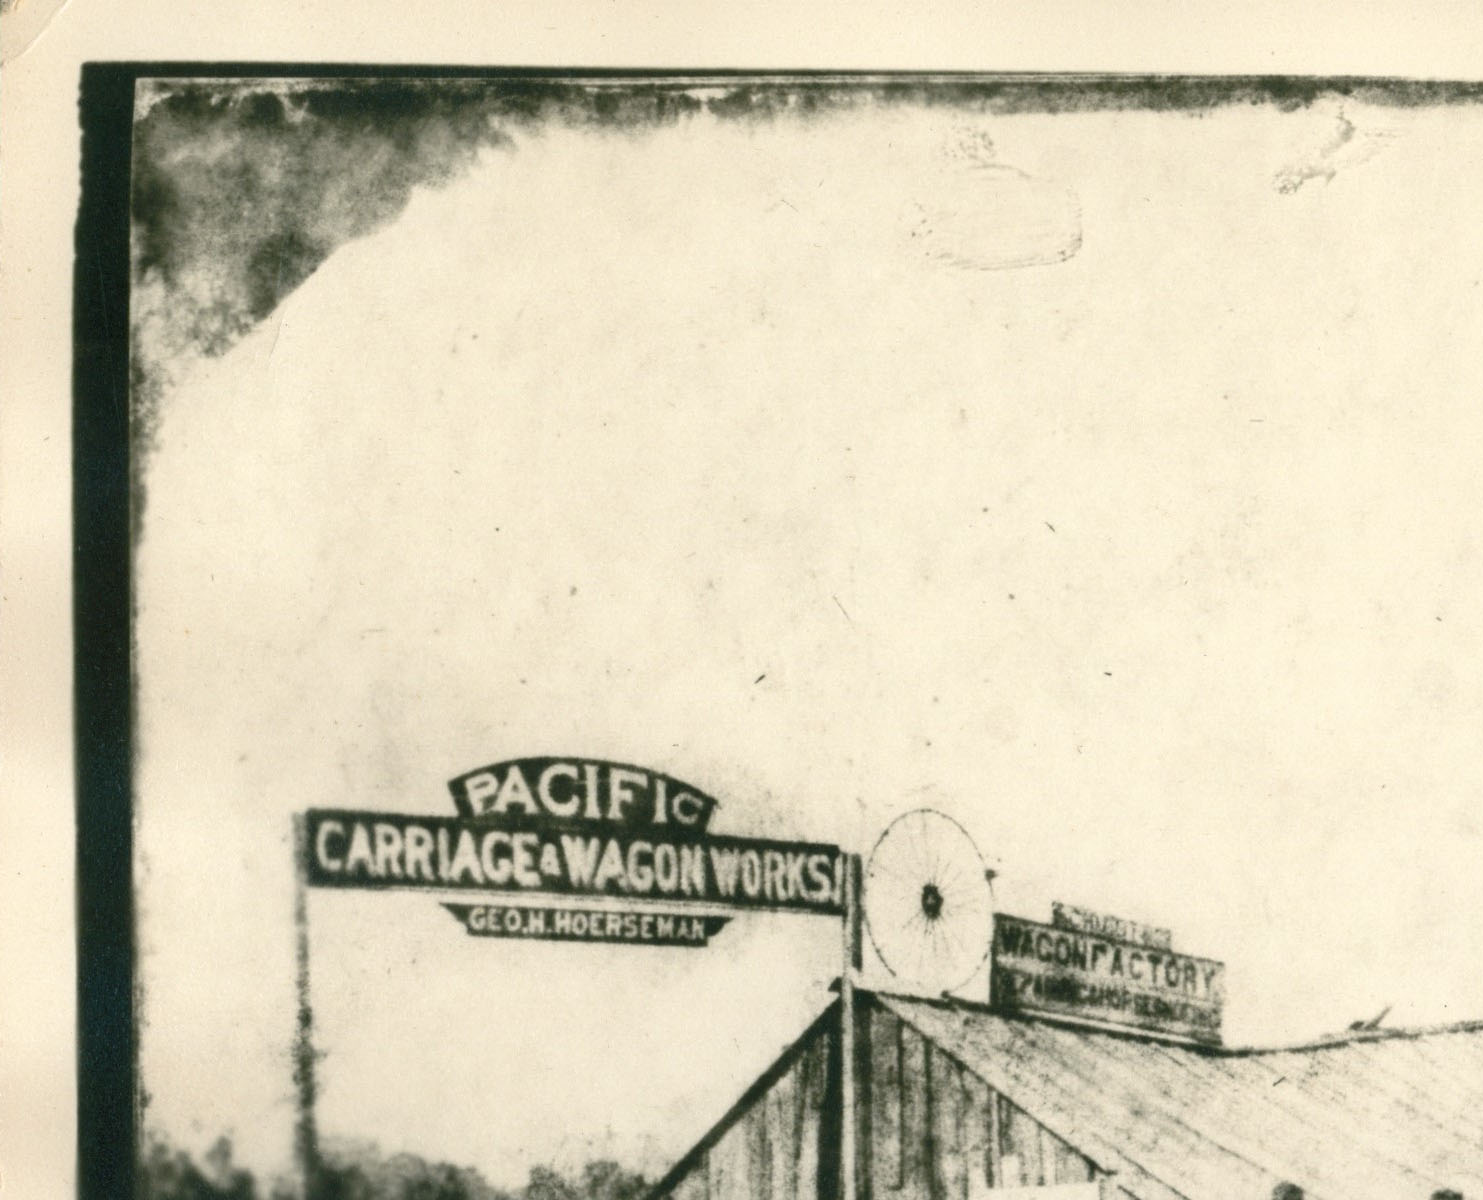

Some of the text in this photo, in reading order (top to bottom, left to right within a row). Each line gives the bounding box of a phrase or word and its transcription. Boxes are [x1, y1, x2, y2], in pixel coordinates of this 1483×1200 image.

[464, 763, 703, 825] PACIFIC
[316, 820, 541, 888] CARRIAGE
[561, 833, 705, 895] WAGON
[709, 846, 833, 904] WORKS
[998, 924, 1088, 972] WAGON
[1090, 942, 1216, 995] FACTORY
